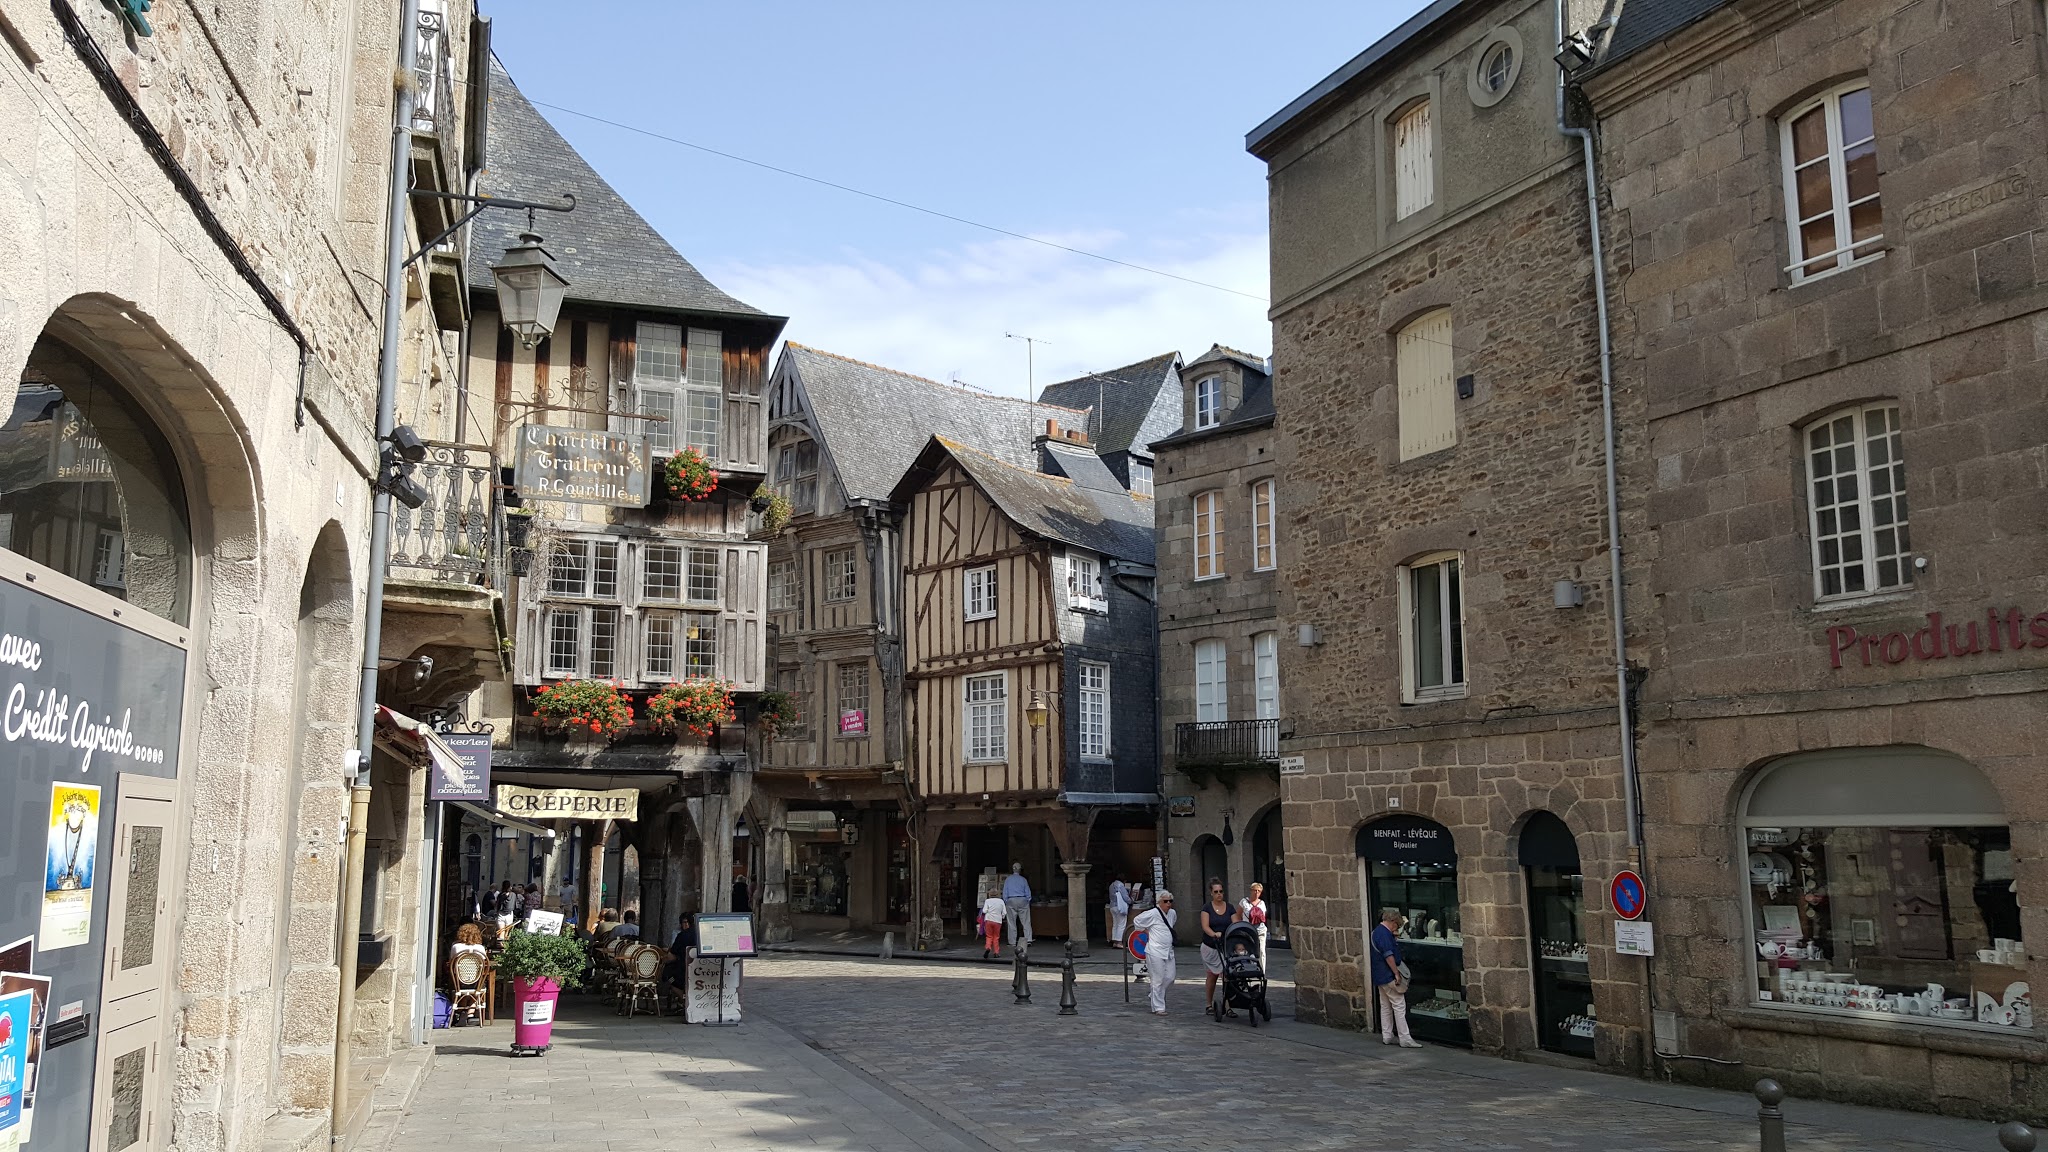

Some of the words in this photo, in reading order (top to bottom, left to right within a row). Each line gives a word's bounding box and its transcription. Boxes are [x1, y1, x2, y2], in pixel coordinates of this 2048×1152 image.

[0, 633, 42, 671] avec
[1826, 607, 2048, 669] Produits
[5, 683, 69, 744] Crédit
[71, 701, 133, 773] Agricole
[508, 792, 627, 812] CRÊPERIE
[1374, 829, 1401, 838] BIENFAIT
[1407, 828, 1438, 839] LÉVÊQUE
[1393, 841, 1418, 850] Bijoutier
